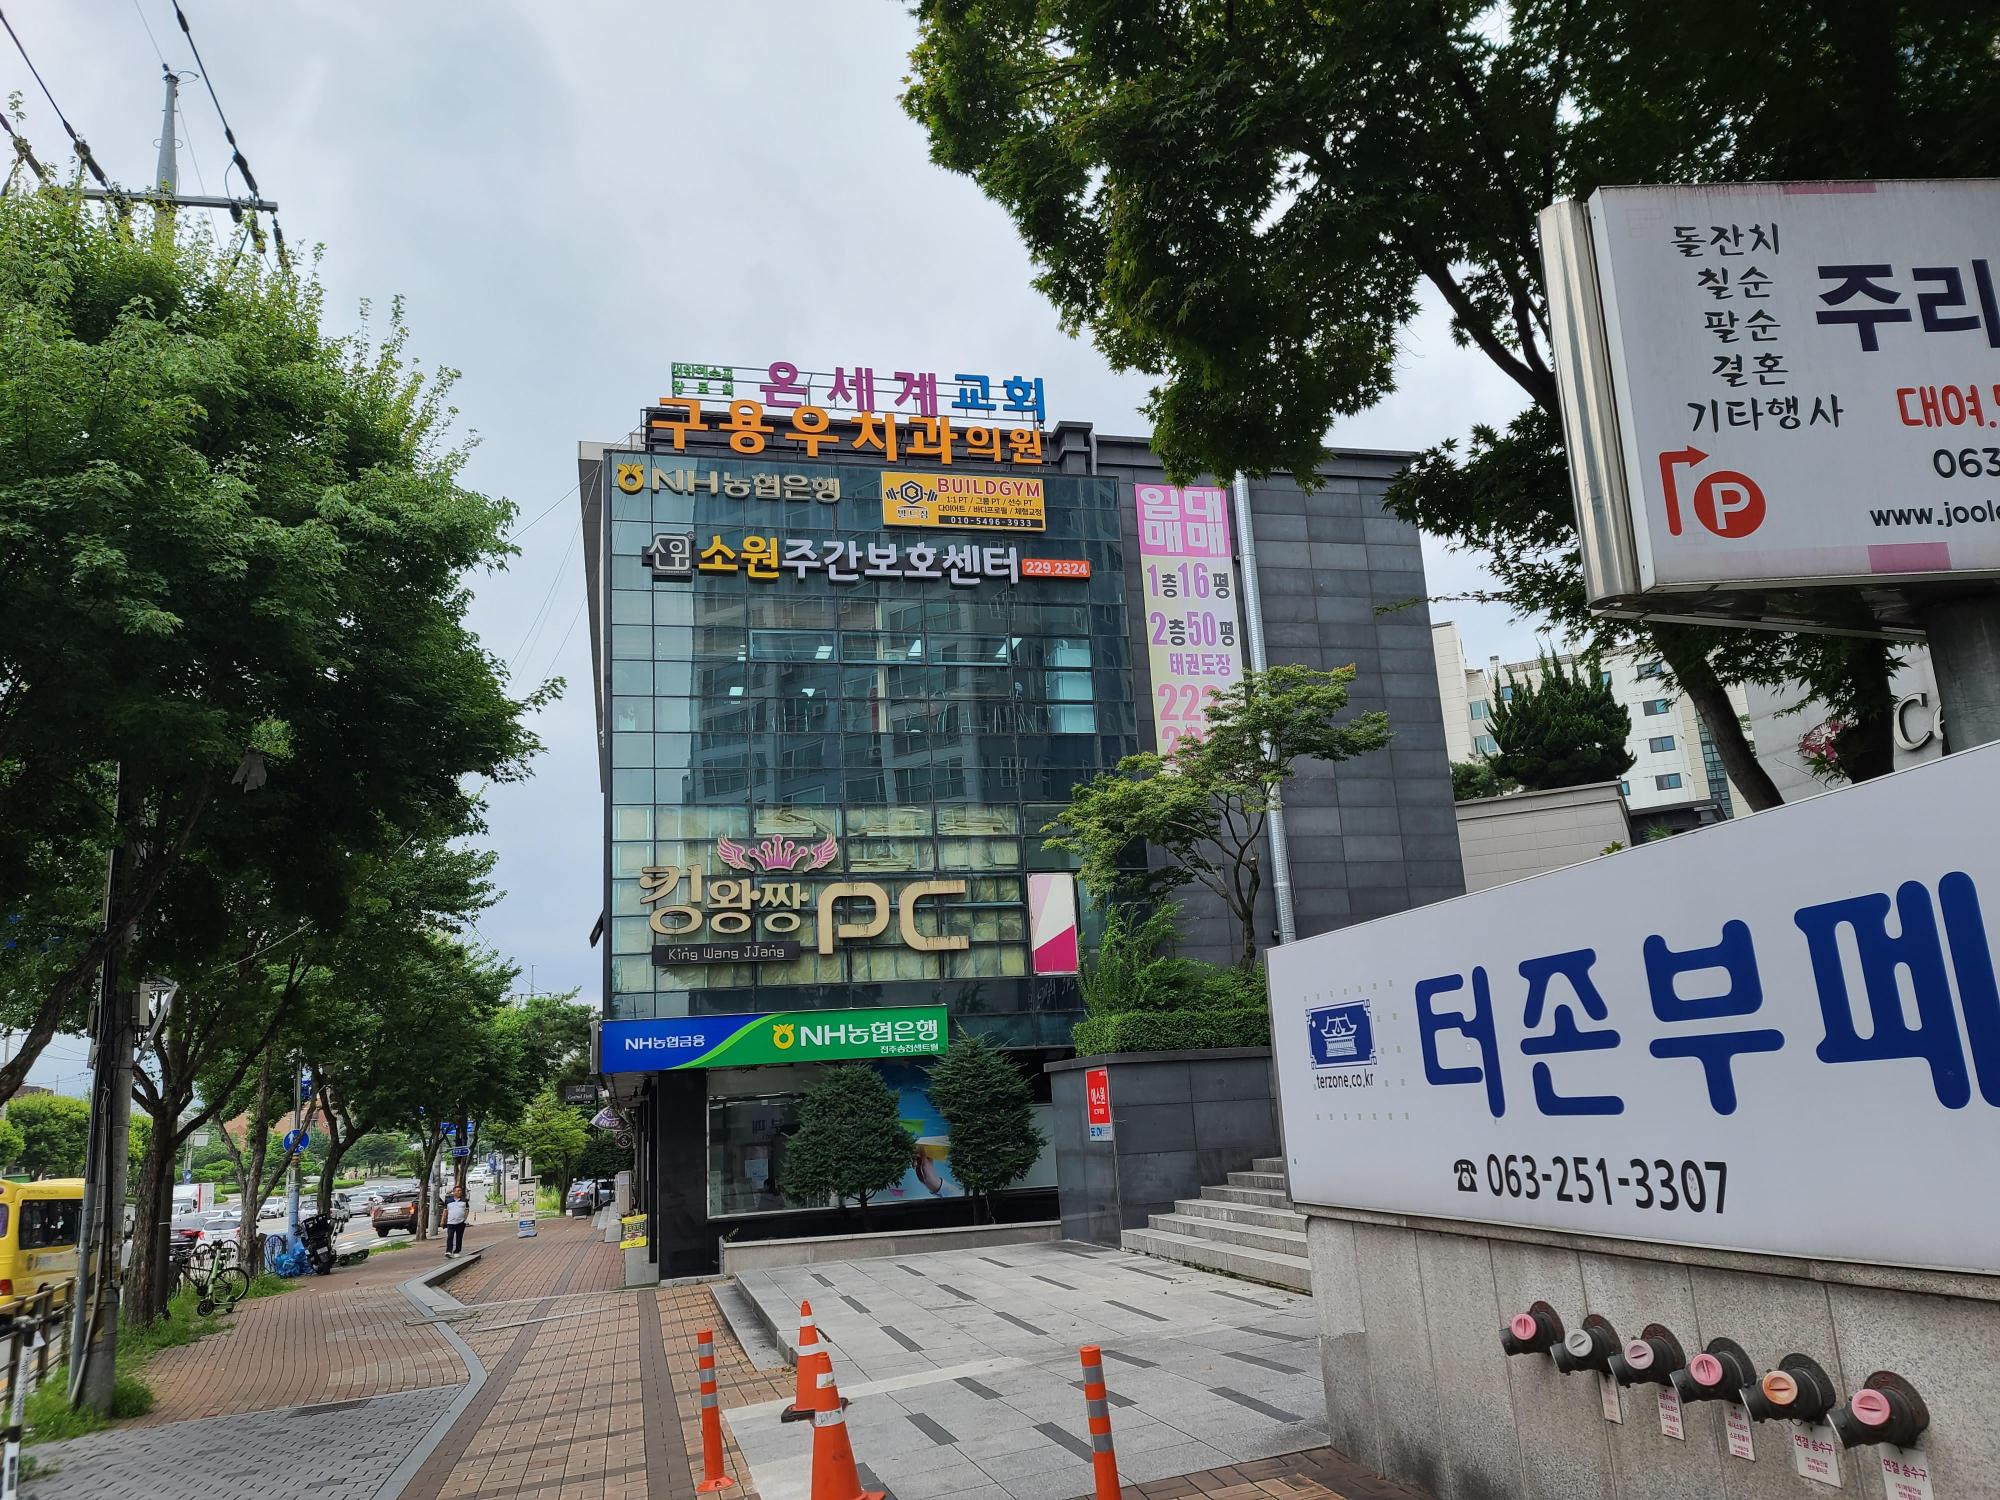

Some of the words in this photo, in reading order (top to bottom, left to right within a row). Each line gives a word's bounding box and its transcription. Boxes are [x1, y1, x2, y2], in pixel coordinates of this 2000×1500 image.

[1670, 222, 1780, 257] 돌잔치
[1697, 266, 1774, 300] 칠순
[1704, 308, 1781, 343] 팔순
[1712, 352, 1789, 387] 결혼
[1687, 393, 1844, 433] 기타행사
[1896, 384, 2000, 428] 대여.
[938, 478, 1040, 497] BUILDGYM
[991, 498, 1001, 506] PT
[1141, 487, 1222, 522] 임대
[950, 516, 1032, 527] 010-5496-3933
[1144, 520, 1226, 555] 매매
[1169, 652, 1231, 677] 태권도장
[640, 864, 810, 935] 킹왕짱
[818, 880, 970, 955] PC
[667, 947, 698, 961] King
[703, 946, 739, 960] Wang
[743, 944, 785, 958] JJang
[625, 1034, 705, 1051] NH농협금융
[800, 1019, 938, 1047] NH농협은행
[1316, 1069, 1374, 1090] terzone.co.kr
[1487, 1153, 1727, 1214] 063-251-3307
[1794, 1434, 1809, 1449] 연결
[1811, 1440, 1833, 1455] 송수구
[1882, 1458, 1900, 1475] 연결
[1902, 1464, 1927, 1482] 송수구
